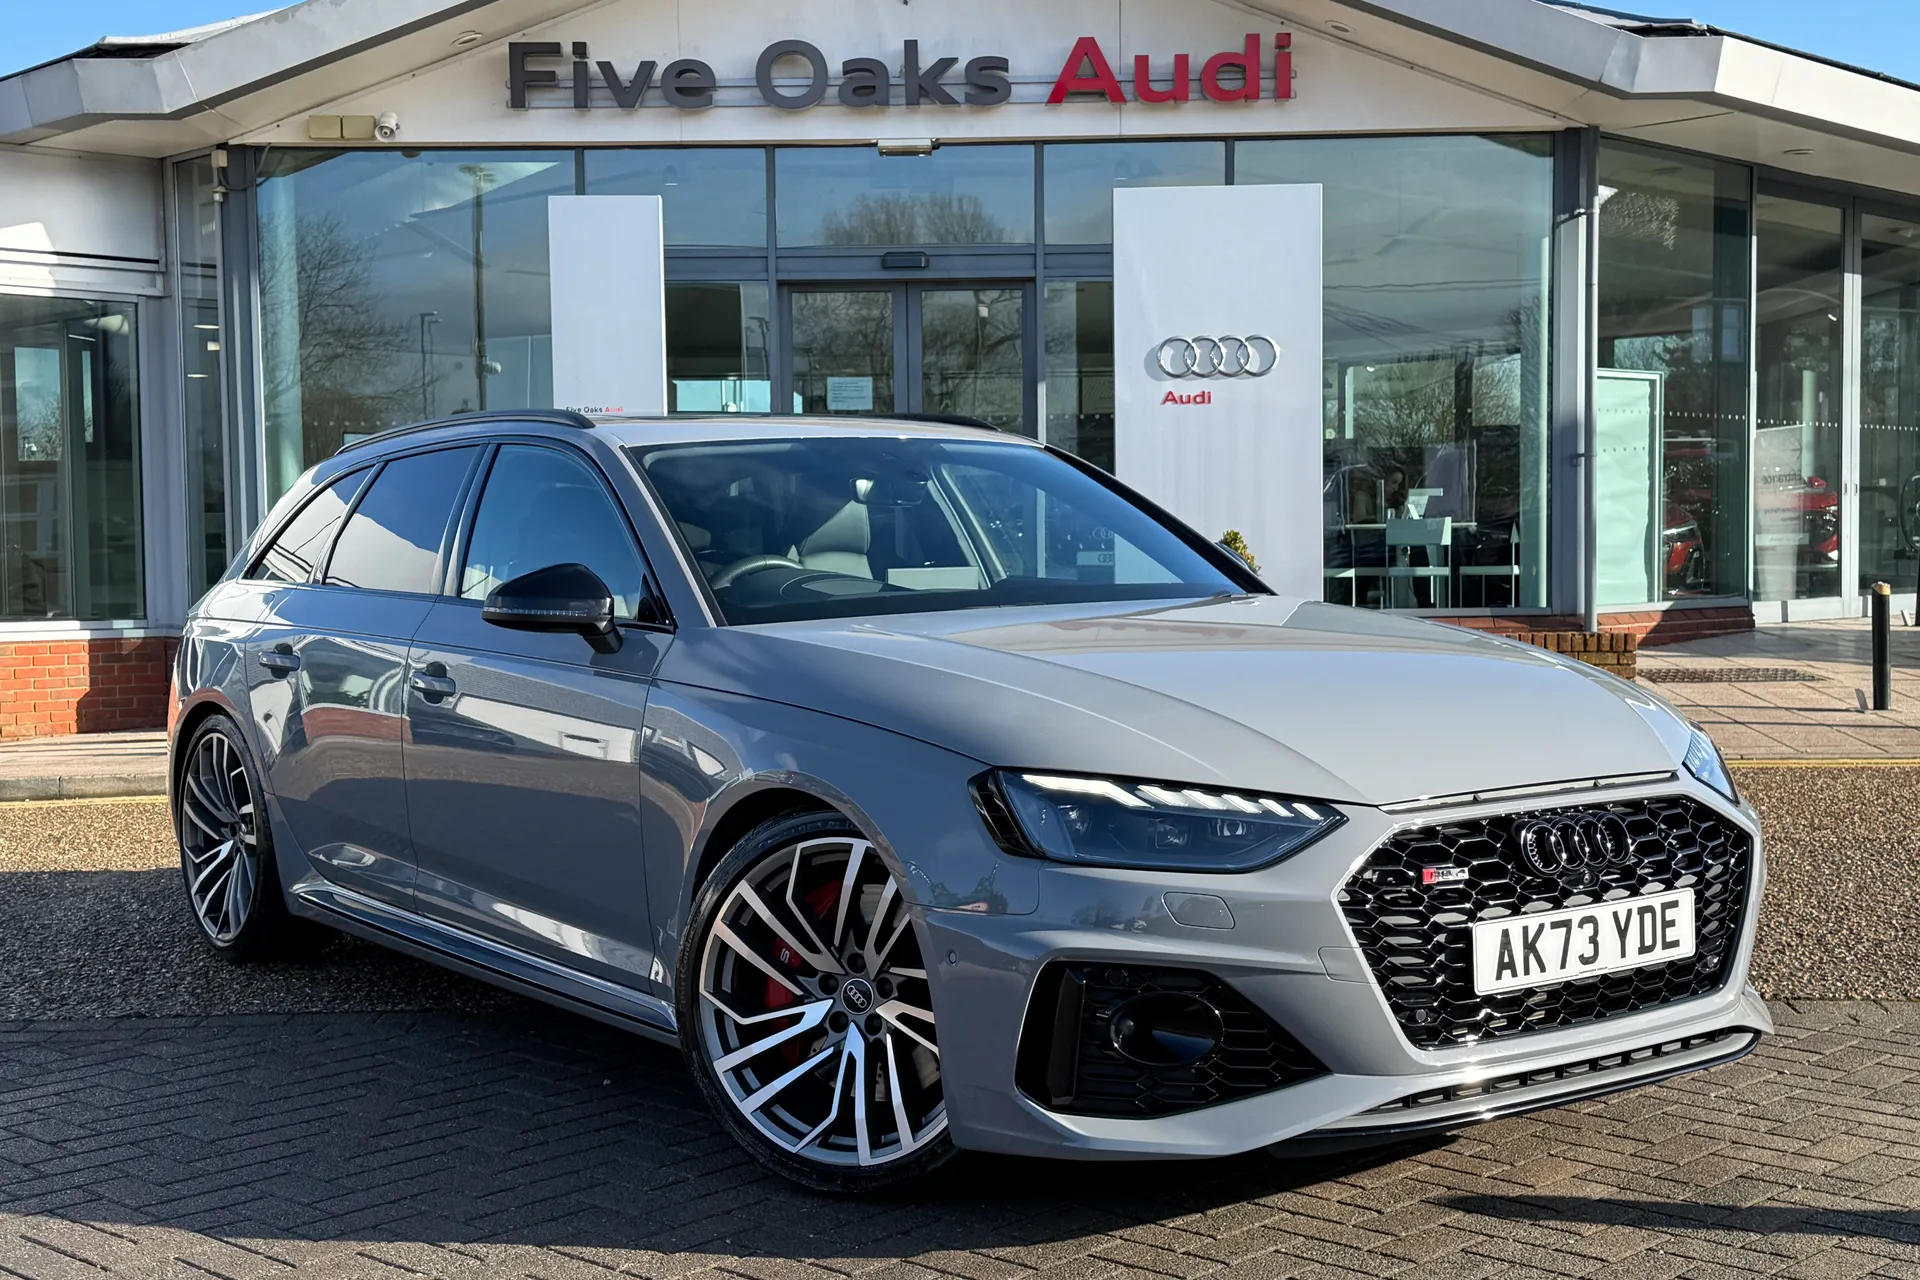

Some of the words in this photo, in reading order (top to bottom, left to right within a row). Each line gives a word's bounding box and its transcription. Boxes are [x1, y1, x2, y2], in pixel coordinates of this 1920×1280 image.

[508, 41, 717, 110] Five
[755, 39, 1012, 109] Oaks
[1045, 32, 1291, 105] Audi
[1161, 391, 1212, 405] Audi
[1495, 915, 1599, 981] AK73
[1612, 900, 1680, 959] YDE
